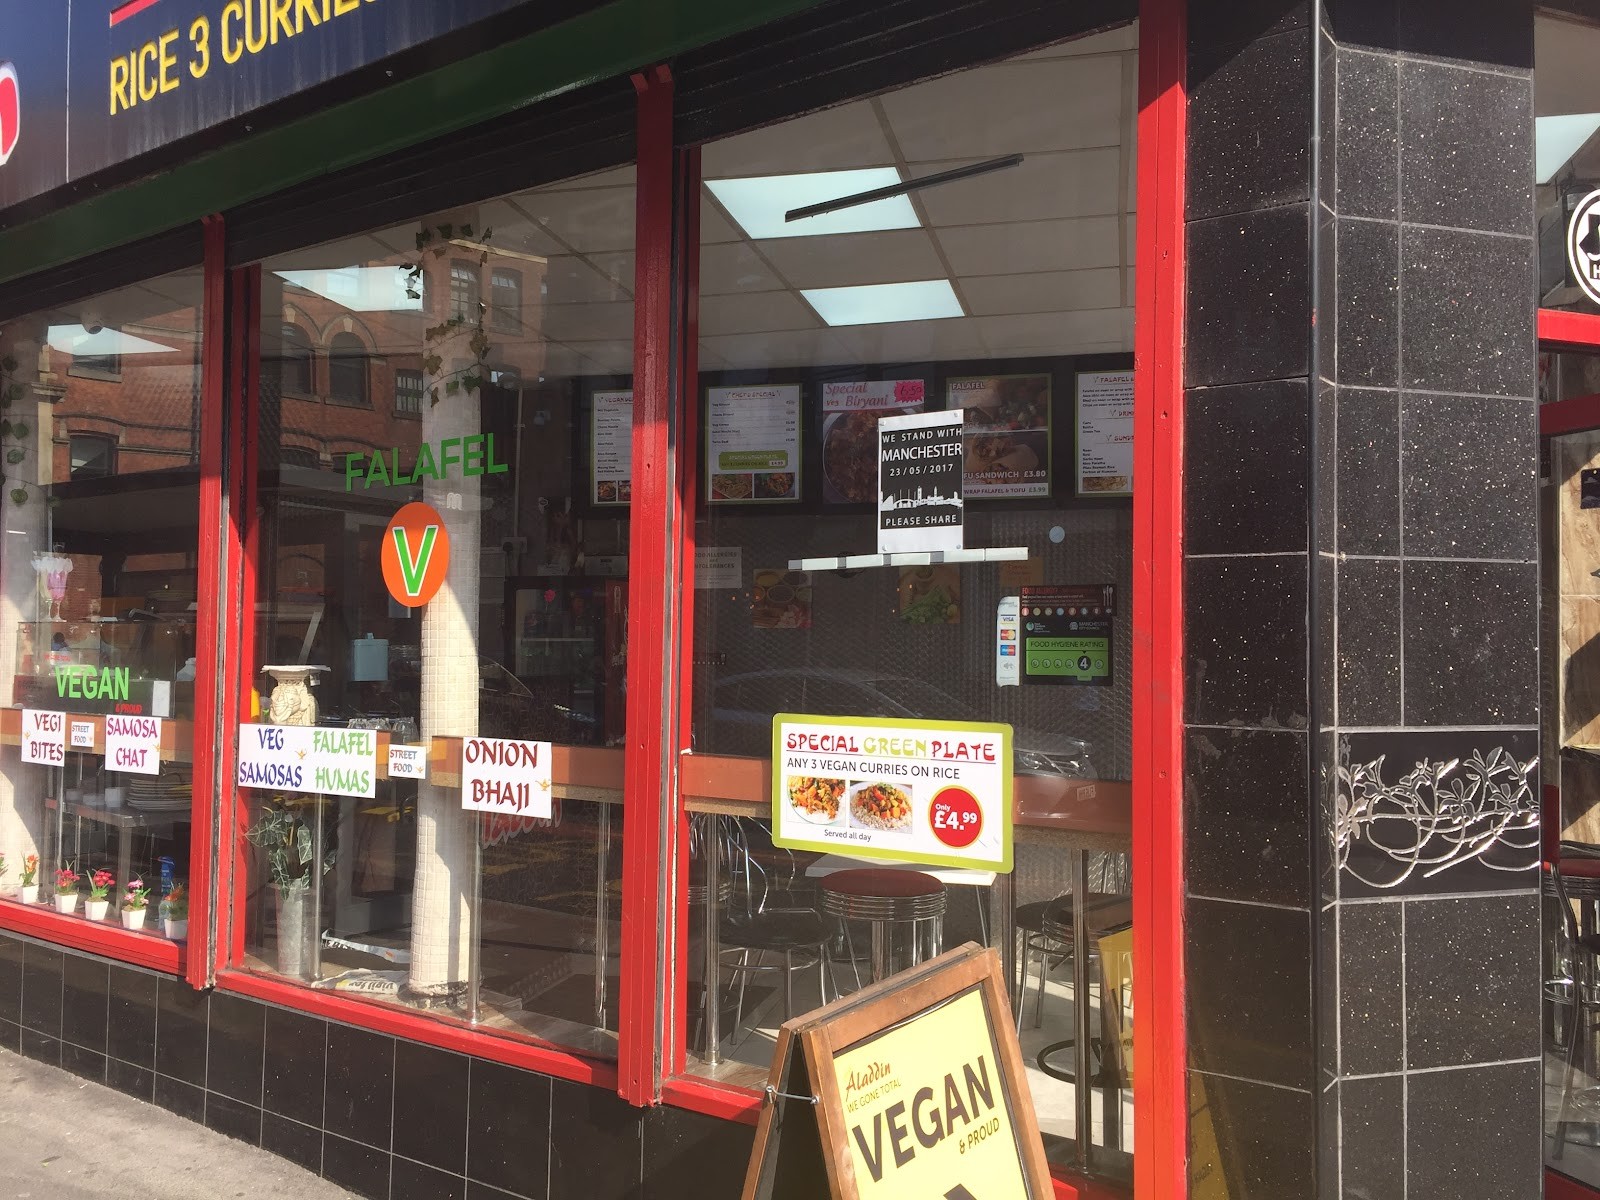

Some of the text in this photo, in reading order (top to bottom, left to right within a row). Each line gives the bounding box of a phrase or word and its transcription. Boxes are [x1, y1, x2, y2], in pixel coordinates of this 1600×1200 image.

[109, 27, 180, 116] RICE
[188, 15, 210, 79] 3
[826, 382, 868, 397] Special
[952, 382, 986, 391] FALAFEL
[845, 395, 889, 408] Biryani
[882, 428, 962, 443] WE STAND WITH
[345, 433, 508, 491] FALAFEL
[882, 443, 962, 462] MANCHESTER
[975, 471, 1019, 479] SANDWICH
[1024, 470, 1047, 478] £3.80
[886, 514, 957, 526] PLEASE SHARE
[392, 525, 439, 596] V
[1080, 657, 1089, 669] 4
[55, 665, 129, 701] VEGAN
[34, 713, 62, 733] VEGI
[71, 724, 89, 734] STREET
[106, 717, 158, 739] SAMOSA
[74, 735, 87, 744] FOOD
[257, 728, 374, 757] VEG FALAFEL
[786, 733, 996, 761] SPECIAL GREEN PLATE
[30, 741, 64, 762] BITES
[115, 747, 148, 768] CHAT
[389, 749, 418, 761] STREET
[465, 739, 539, 769] ONION
[239, 761, 370, 794] SAMOSAS HUMAS
[393, 762, 413, 773] FOOD
[787, 757, 960, 780] ANY 3 VEGAN CURRIES ON RICE
[470, 778, 530, 814] BHAJI
[935, 803, 951, 812] Only
[934, 811, 978, 831] £4.99
[823, 829, 872, 843] Served all day
[367, 981, 394, 992] vigil
[845, 1062, 891, 1102] Aladdin
[847, 1077, 902, 1114] WE GONE TOTAL
[851, 1055, 995, 1183] VEGAN
[959, 1117, 1000, 1155] & PROUD
